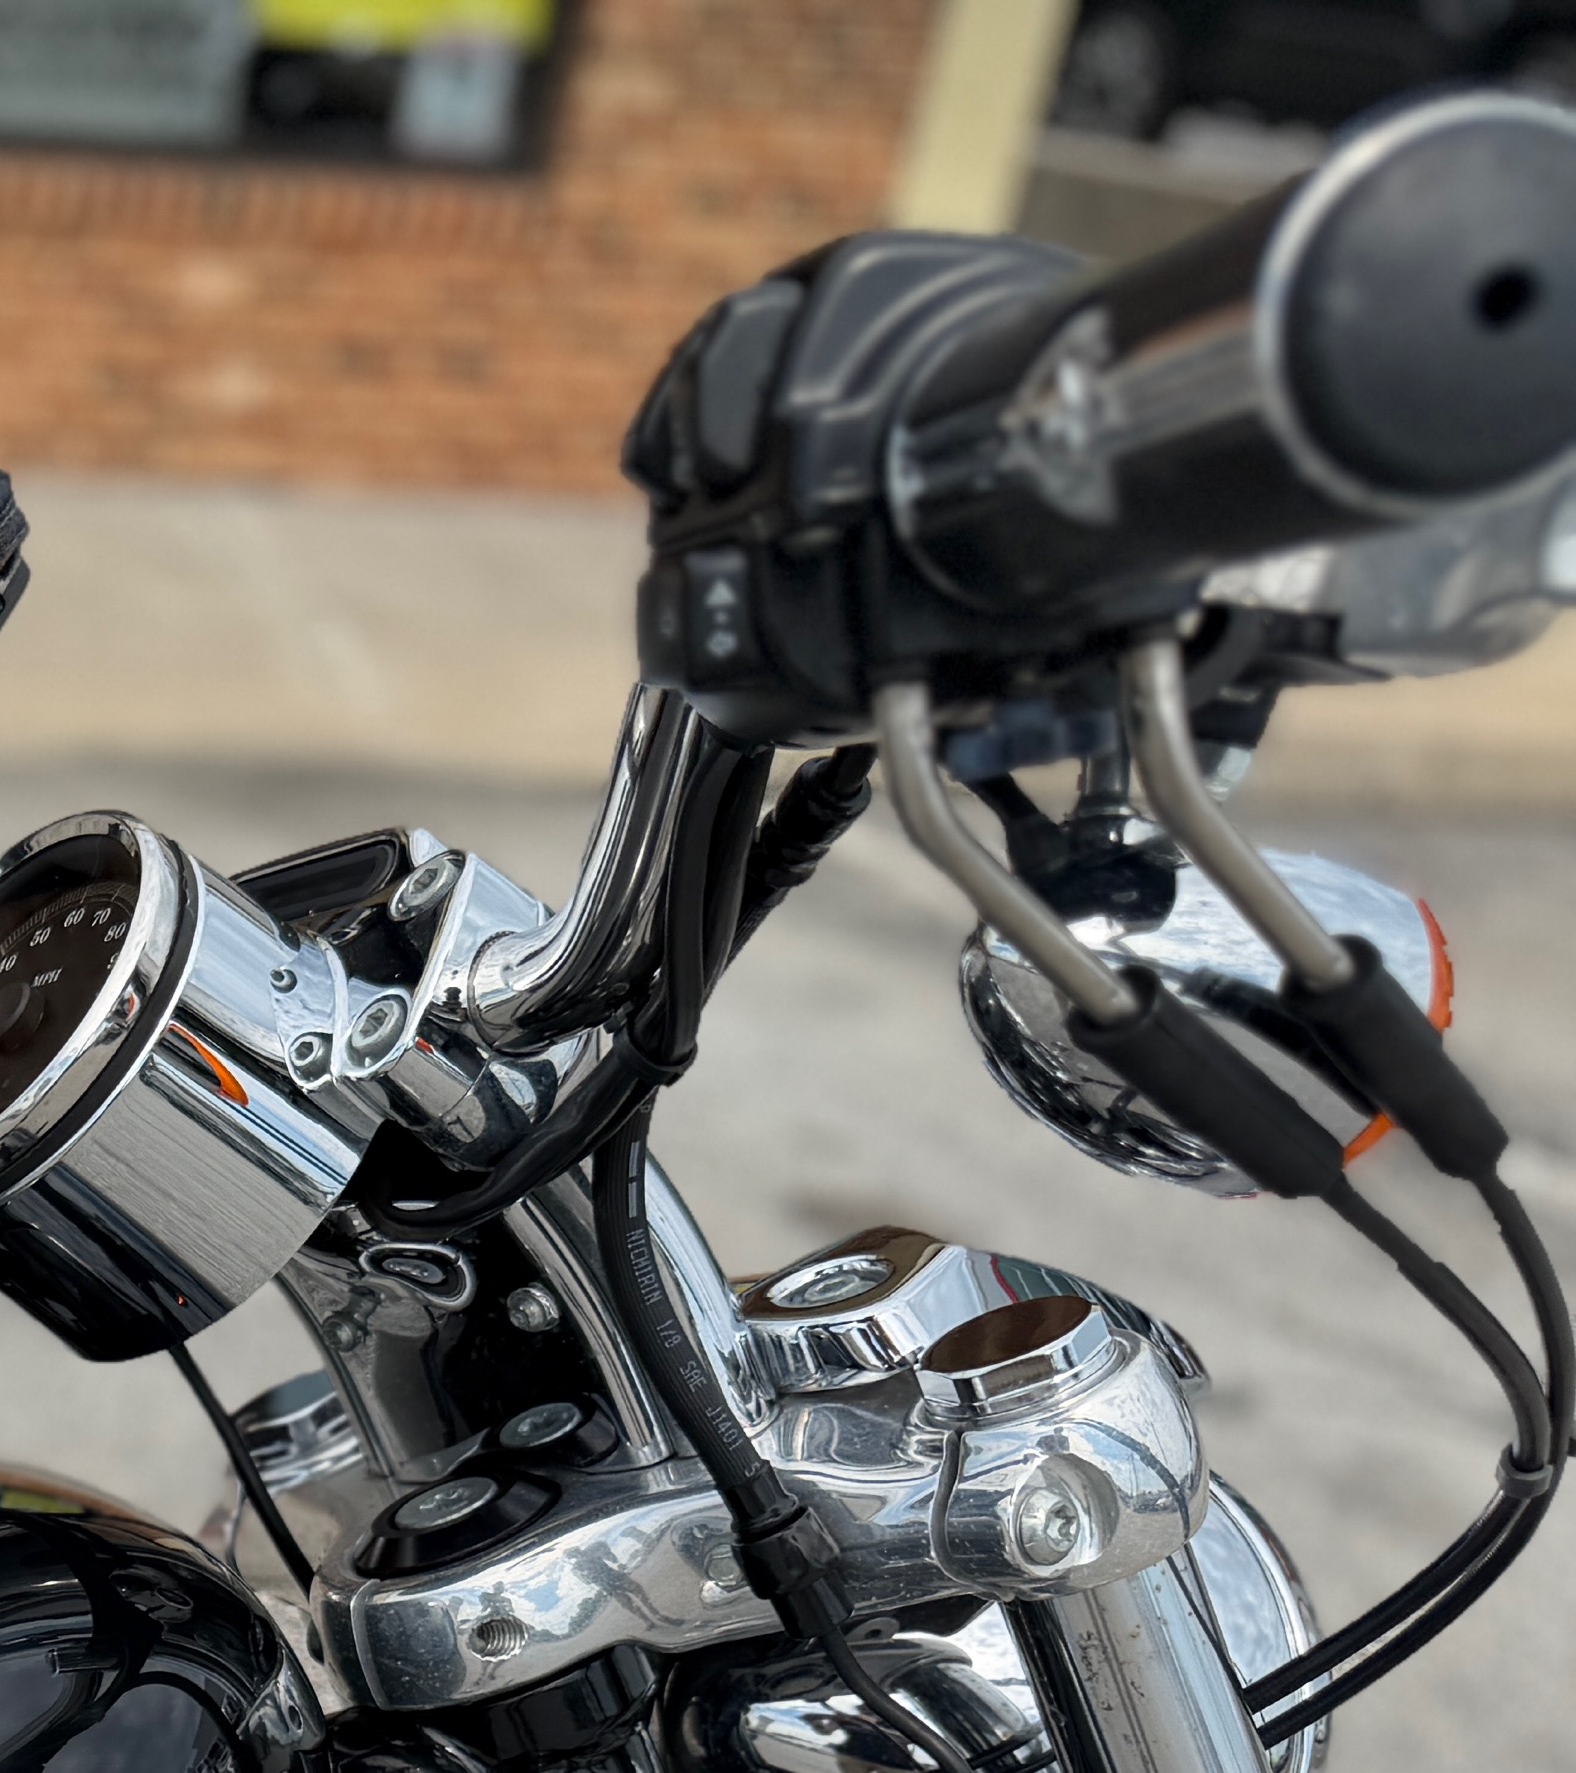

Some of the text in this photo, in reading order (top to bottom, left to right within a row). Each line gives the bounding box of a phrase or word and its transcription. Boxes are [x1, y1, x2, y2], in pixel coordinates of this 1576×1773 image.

[63, 908, 85, 928] 60
[92, 907, 112, 927] 70
[29, 926, 51, 947] 50
[104, 922, 126, 942] 80
[30, 967, 63, 988] MPH
[626, 1228, 663, 1305] NICHIRIN
[657, 1320, 681, 1348] 1/8
[680, 1361, 708, 1393] SAE
